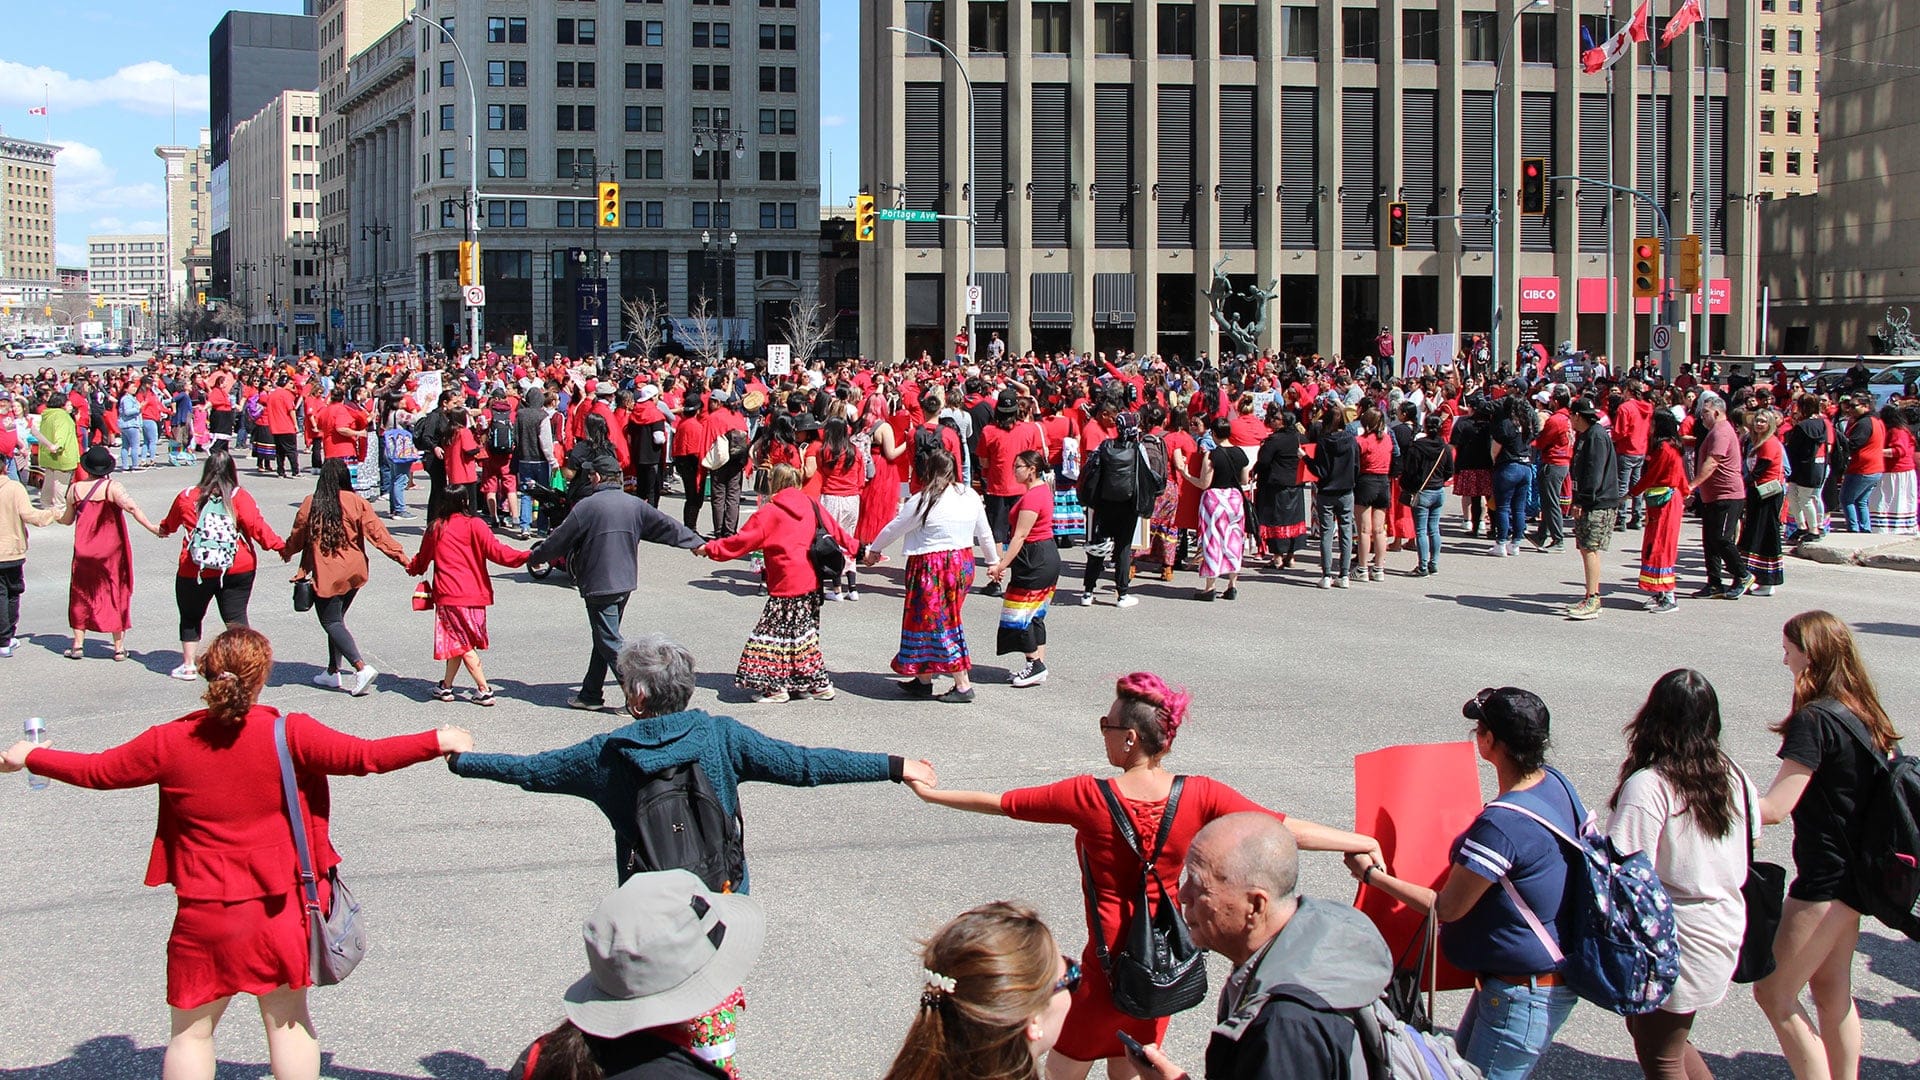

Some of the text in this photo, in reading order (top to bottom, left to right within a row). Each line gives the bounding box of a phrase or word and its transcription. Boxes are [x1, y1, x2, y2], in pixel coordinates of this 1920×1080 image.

[882, 209, 936, 220] Portage Ave
[1523, 289, 1546, 300] CIBC
[1697, 287, 1726, 298] Bking
[1697, 296, 1721, 305] Ctre
